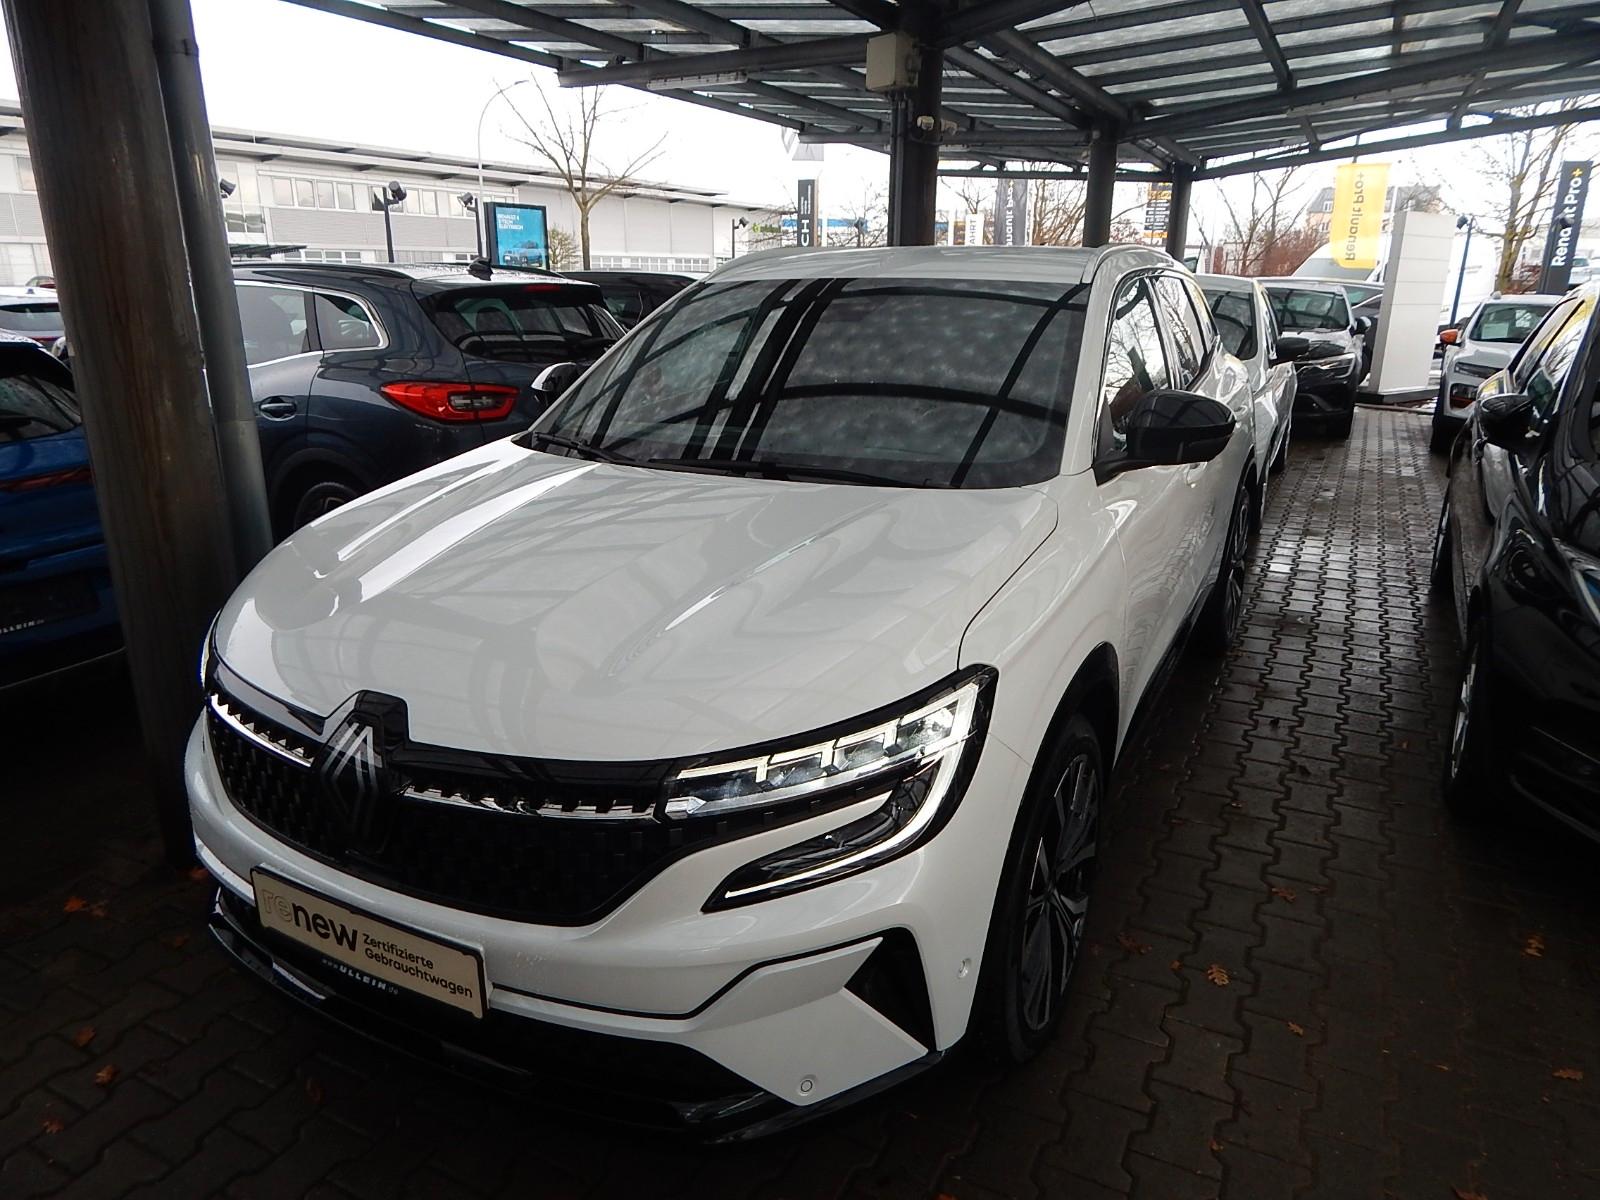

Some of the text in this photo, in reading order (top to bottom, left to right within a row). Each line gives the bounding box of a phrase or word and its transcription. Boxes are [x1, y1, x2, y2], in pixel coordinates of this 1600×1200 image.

[1563, 168, 1583, 205] Pro+
[262, 890, 358, 952] renew
[363, 933, 434, 969] Zertifizierte
[365, 949, 473, 999] Gebrauchtwagen
